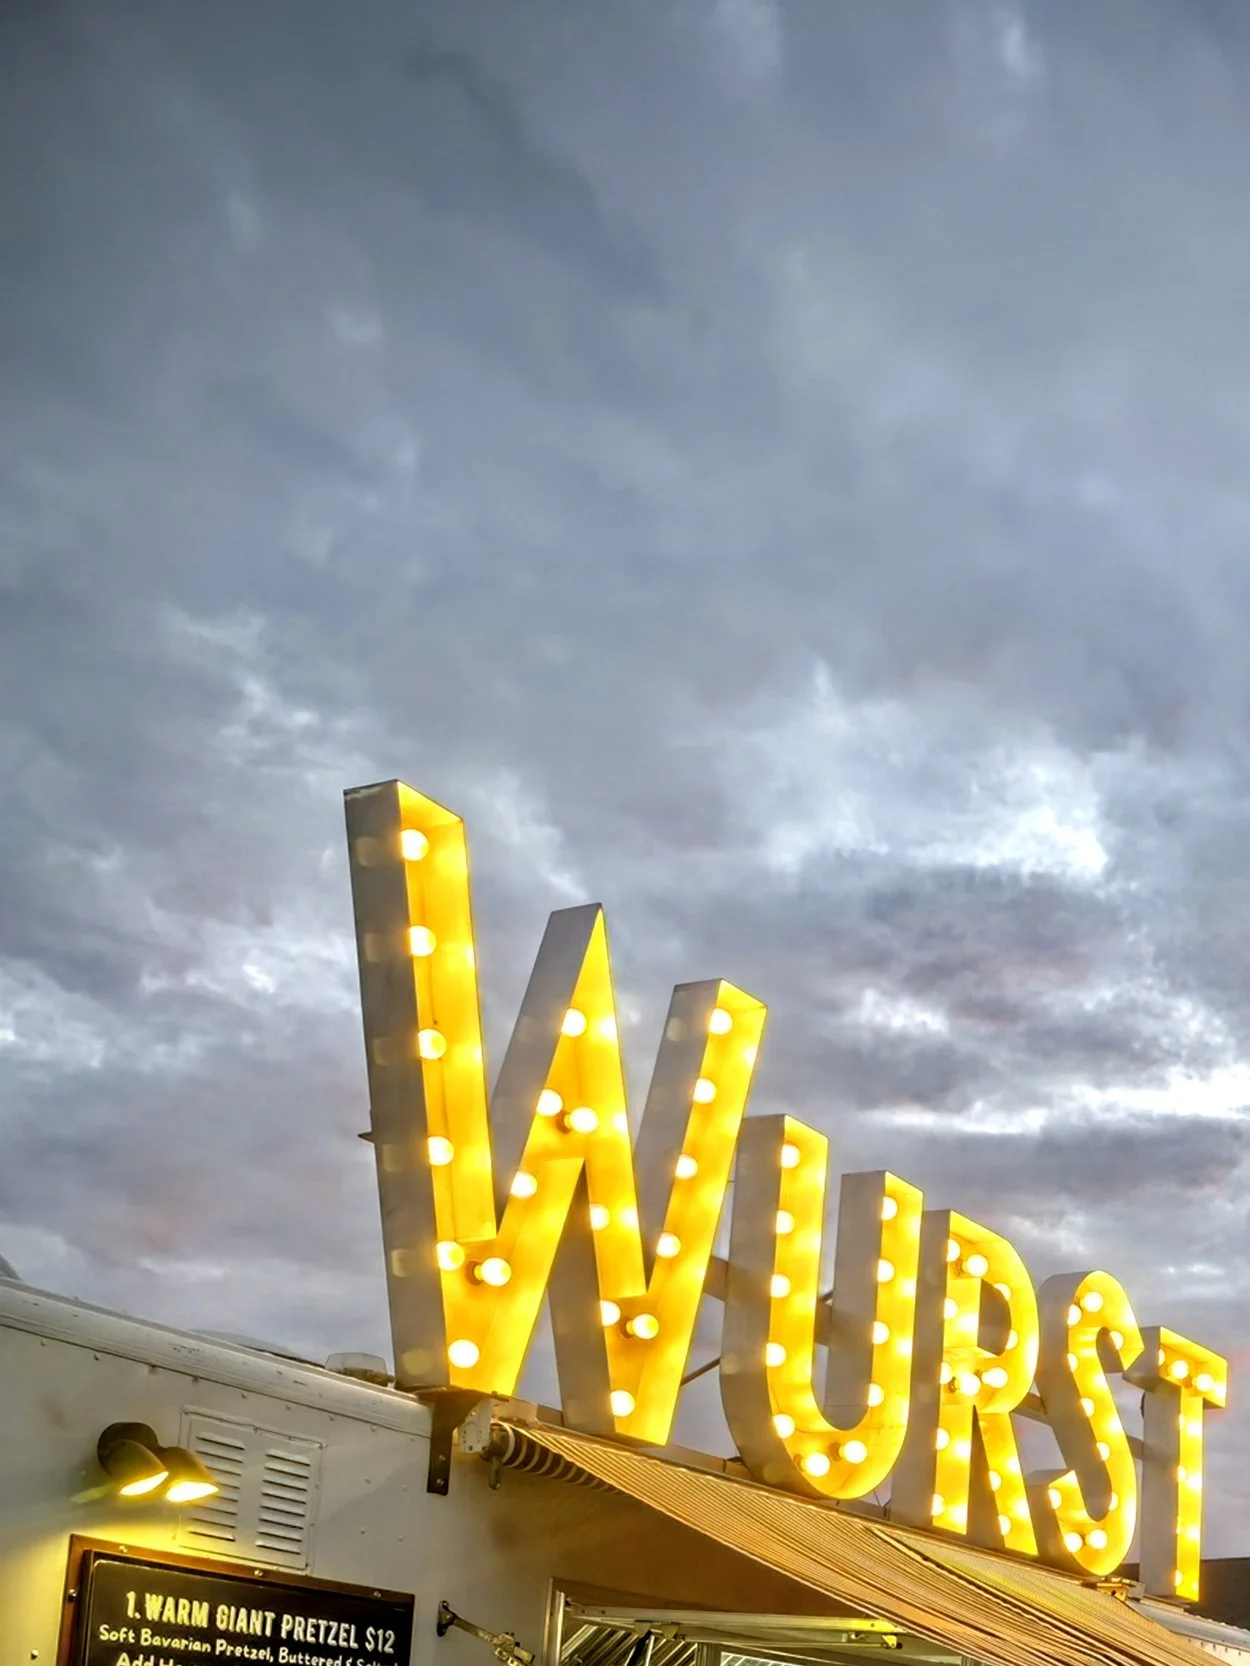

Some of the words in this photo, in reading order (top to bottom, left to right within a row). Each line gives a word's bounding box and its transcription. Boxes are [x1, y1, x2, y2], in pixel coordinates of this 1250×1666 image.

[344, 780, 1228, 1602] WURST
[99, 1624, 135, 1643] Soft
[140, 1628, 211, 1652] Bavarian
[215, 1639, 274, 1663] Pretzel,
[126, 1591, 141, 1619] 1.
[145, 1592, 209, 1628] WARM
[216, 1605, 276, 1637] GIANT
[281, 1614, 359, 1649] PRETZEL
[365, 1626, 395, 1654] $12
